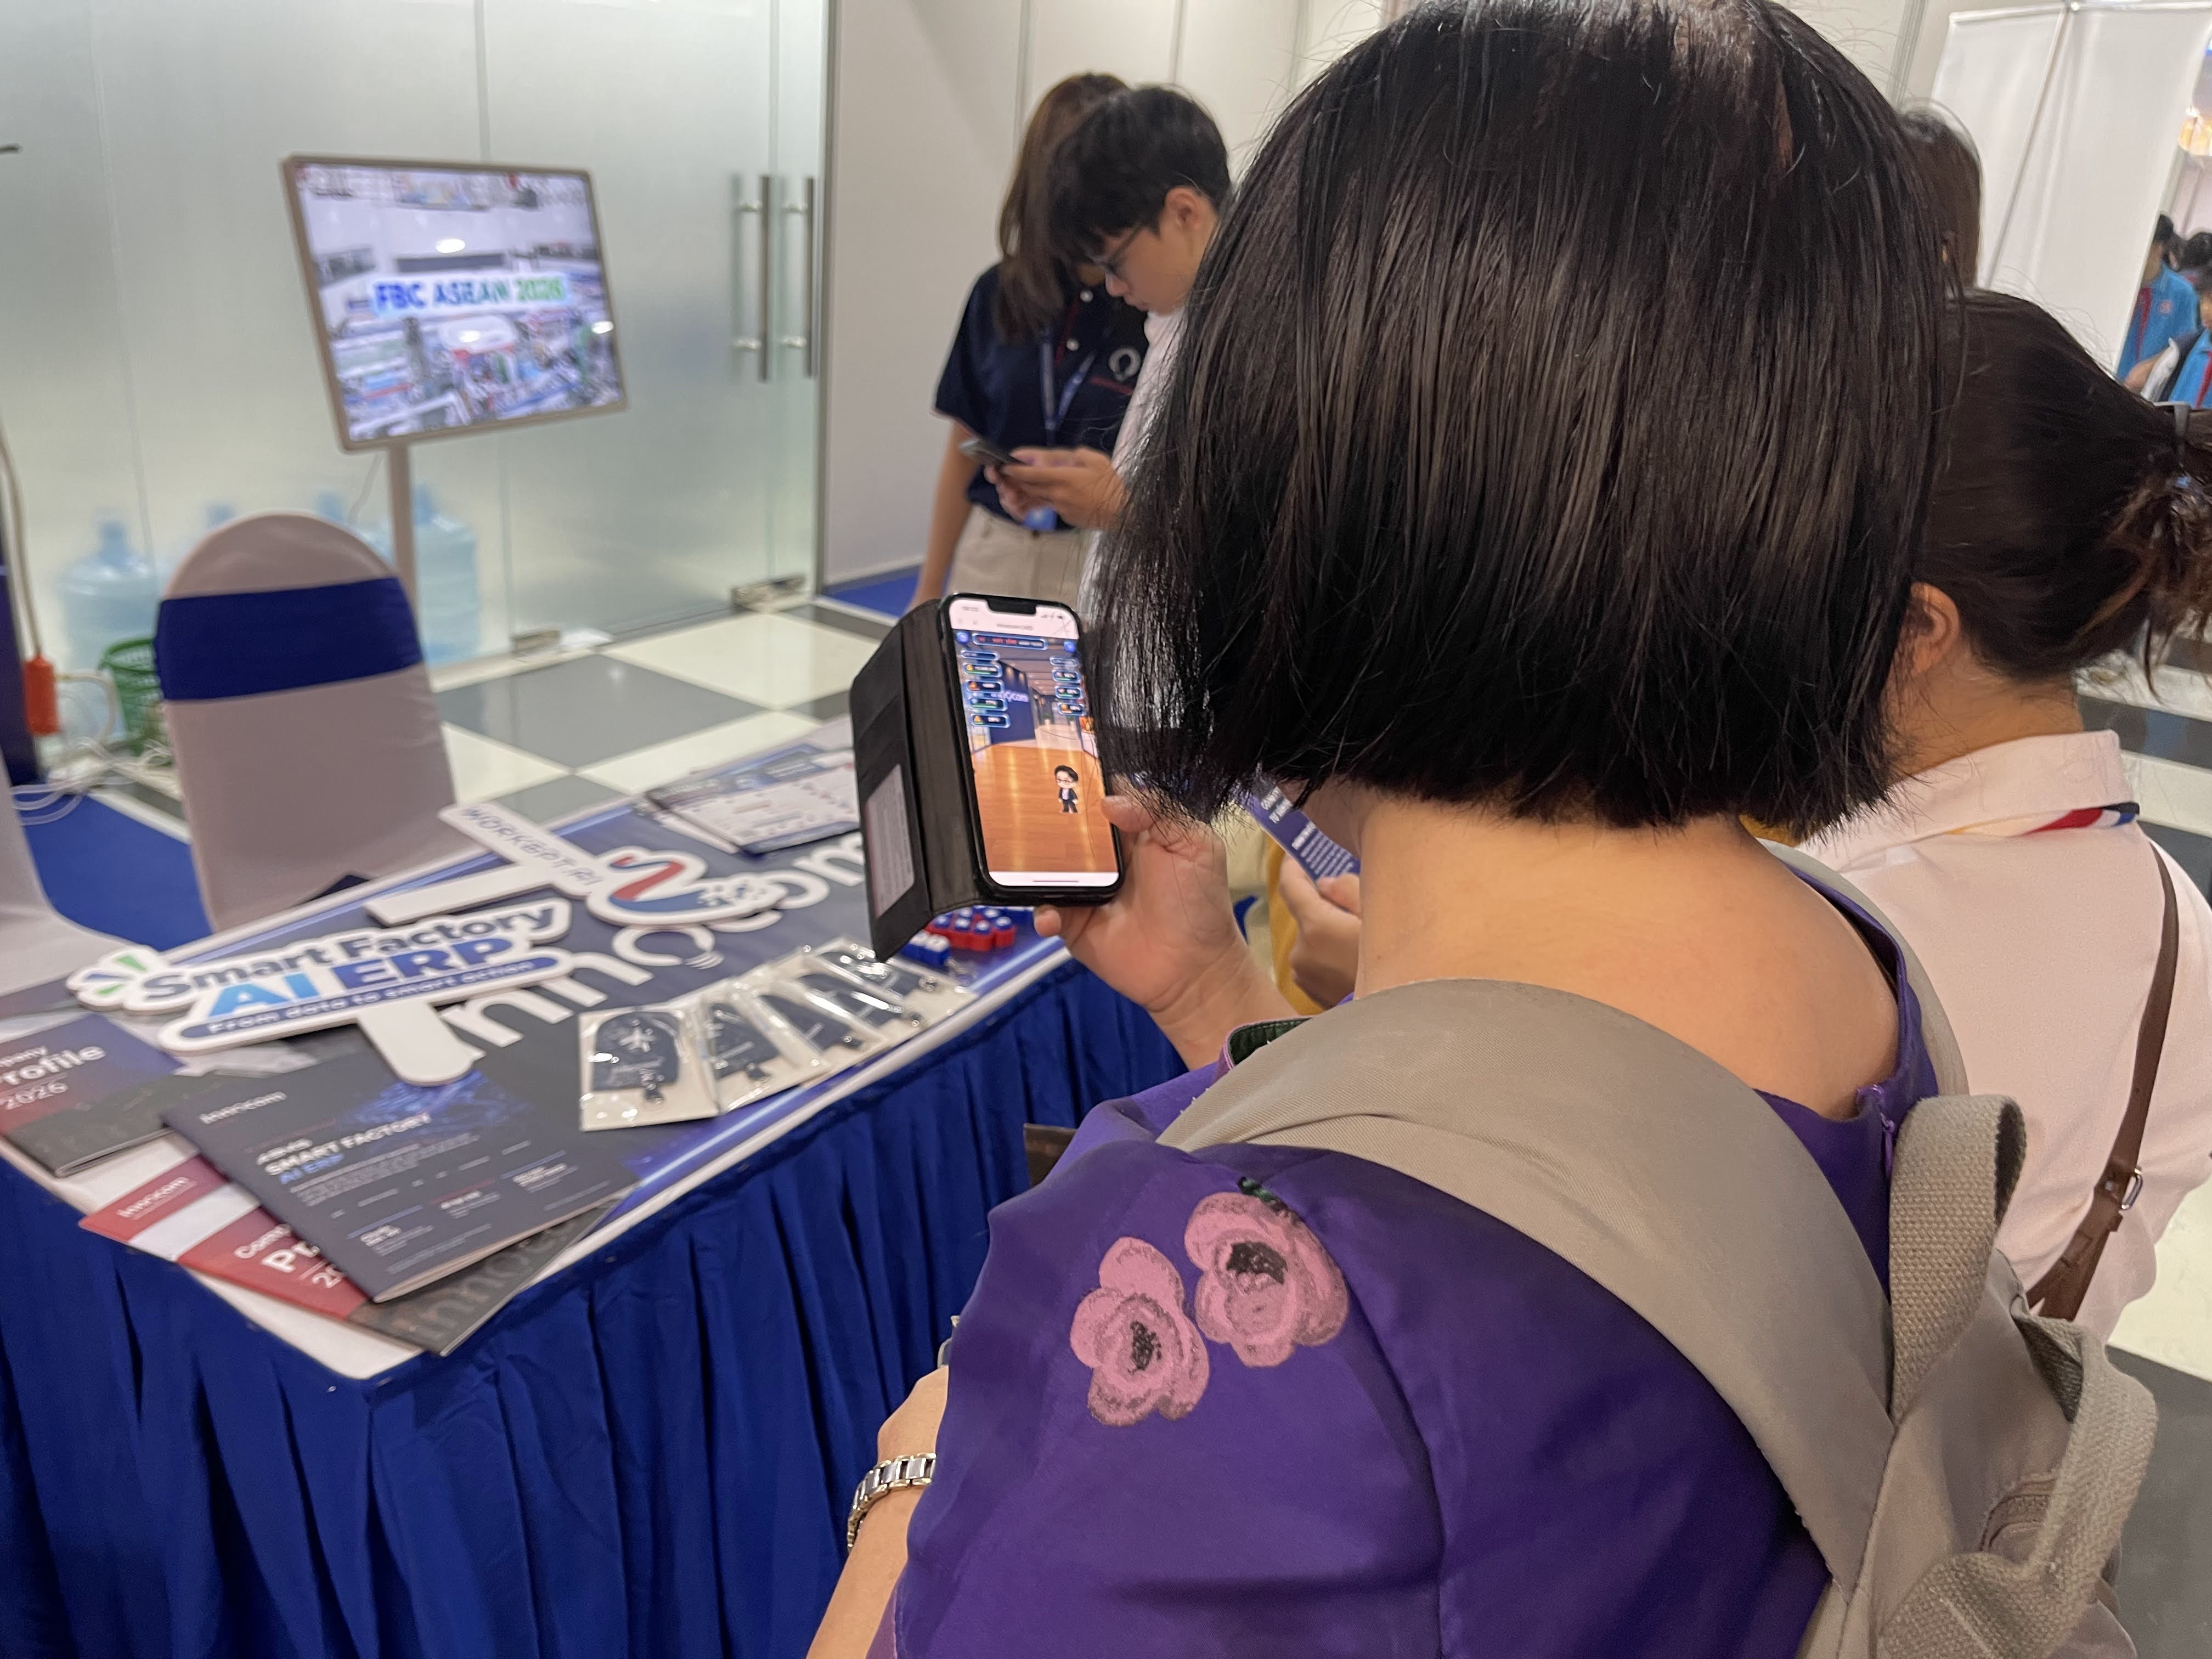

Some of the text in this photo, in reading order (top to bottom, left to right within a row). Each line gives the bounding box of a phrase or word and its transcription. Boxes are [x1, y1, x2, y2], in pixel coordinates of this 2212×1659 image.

[375, 283, 426, 309] FBC
[434, 280, 510, 304] ASEAN
[143, 908, 553, 1001] Smart Factory
[208, 938, 513, 1018] AI ERP
[285, 997, 348, 1019] data
[352, 990, 381, 1005] to
[385, 974, 459, 999] smart
[461, 961, 536, 983] action
[0, 1046, 106, 1085] rofile
[264, 1141, 340, 1176] SMART
[340, 1112, 432, 1148] FACTORY
